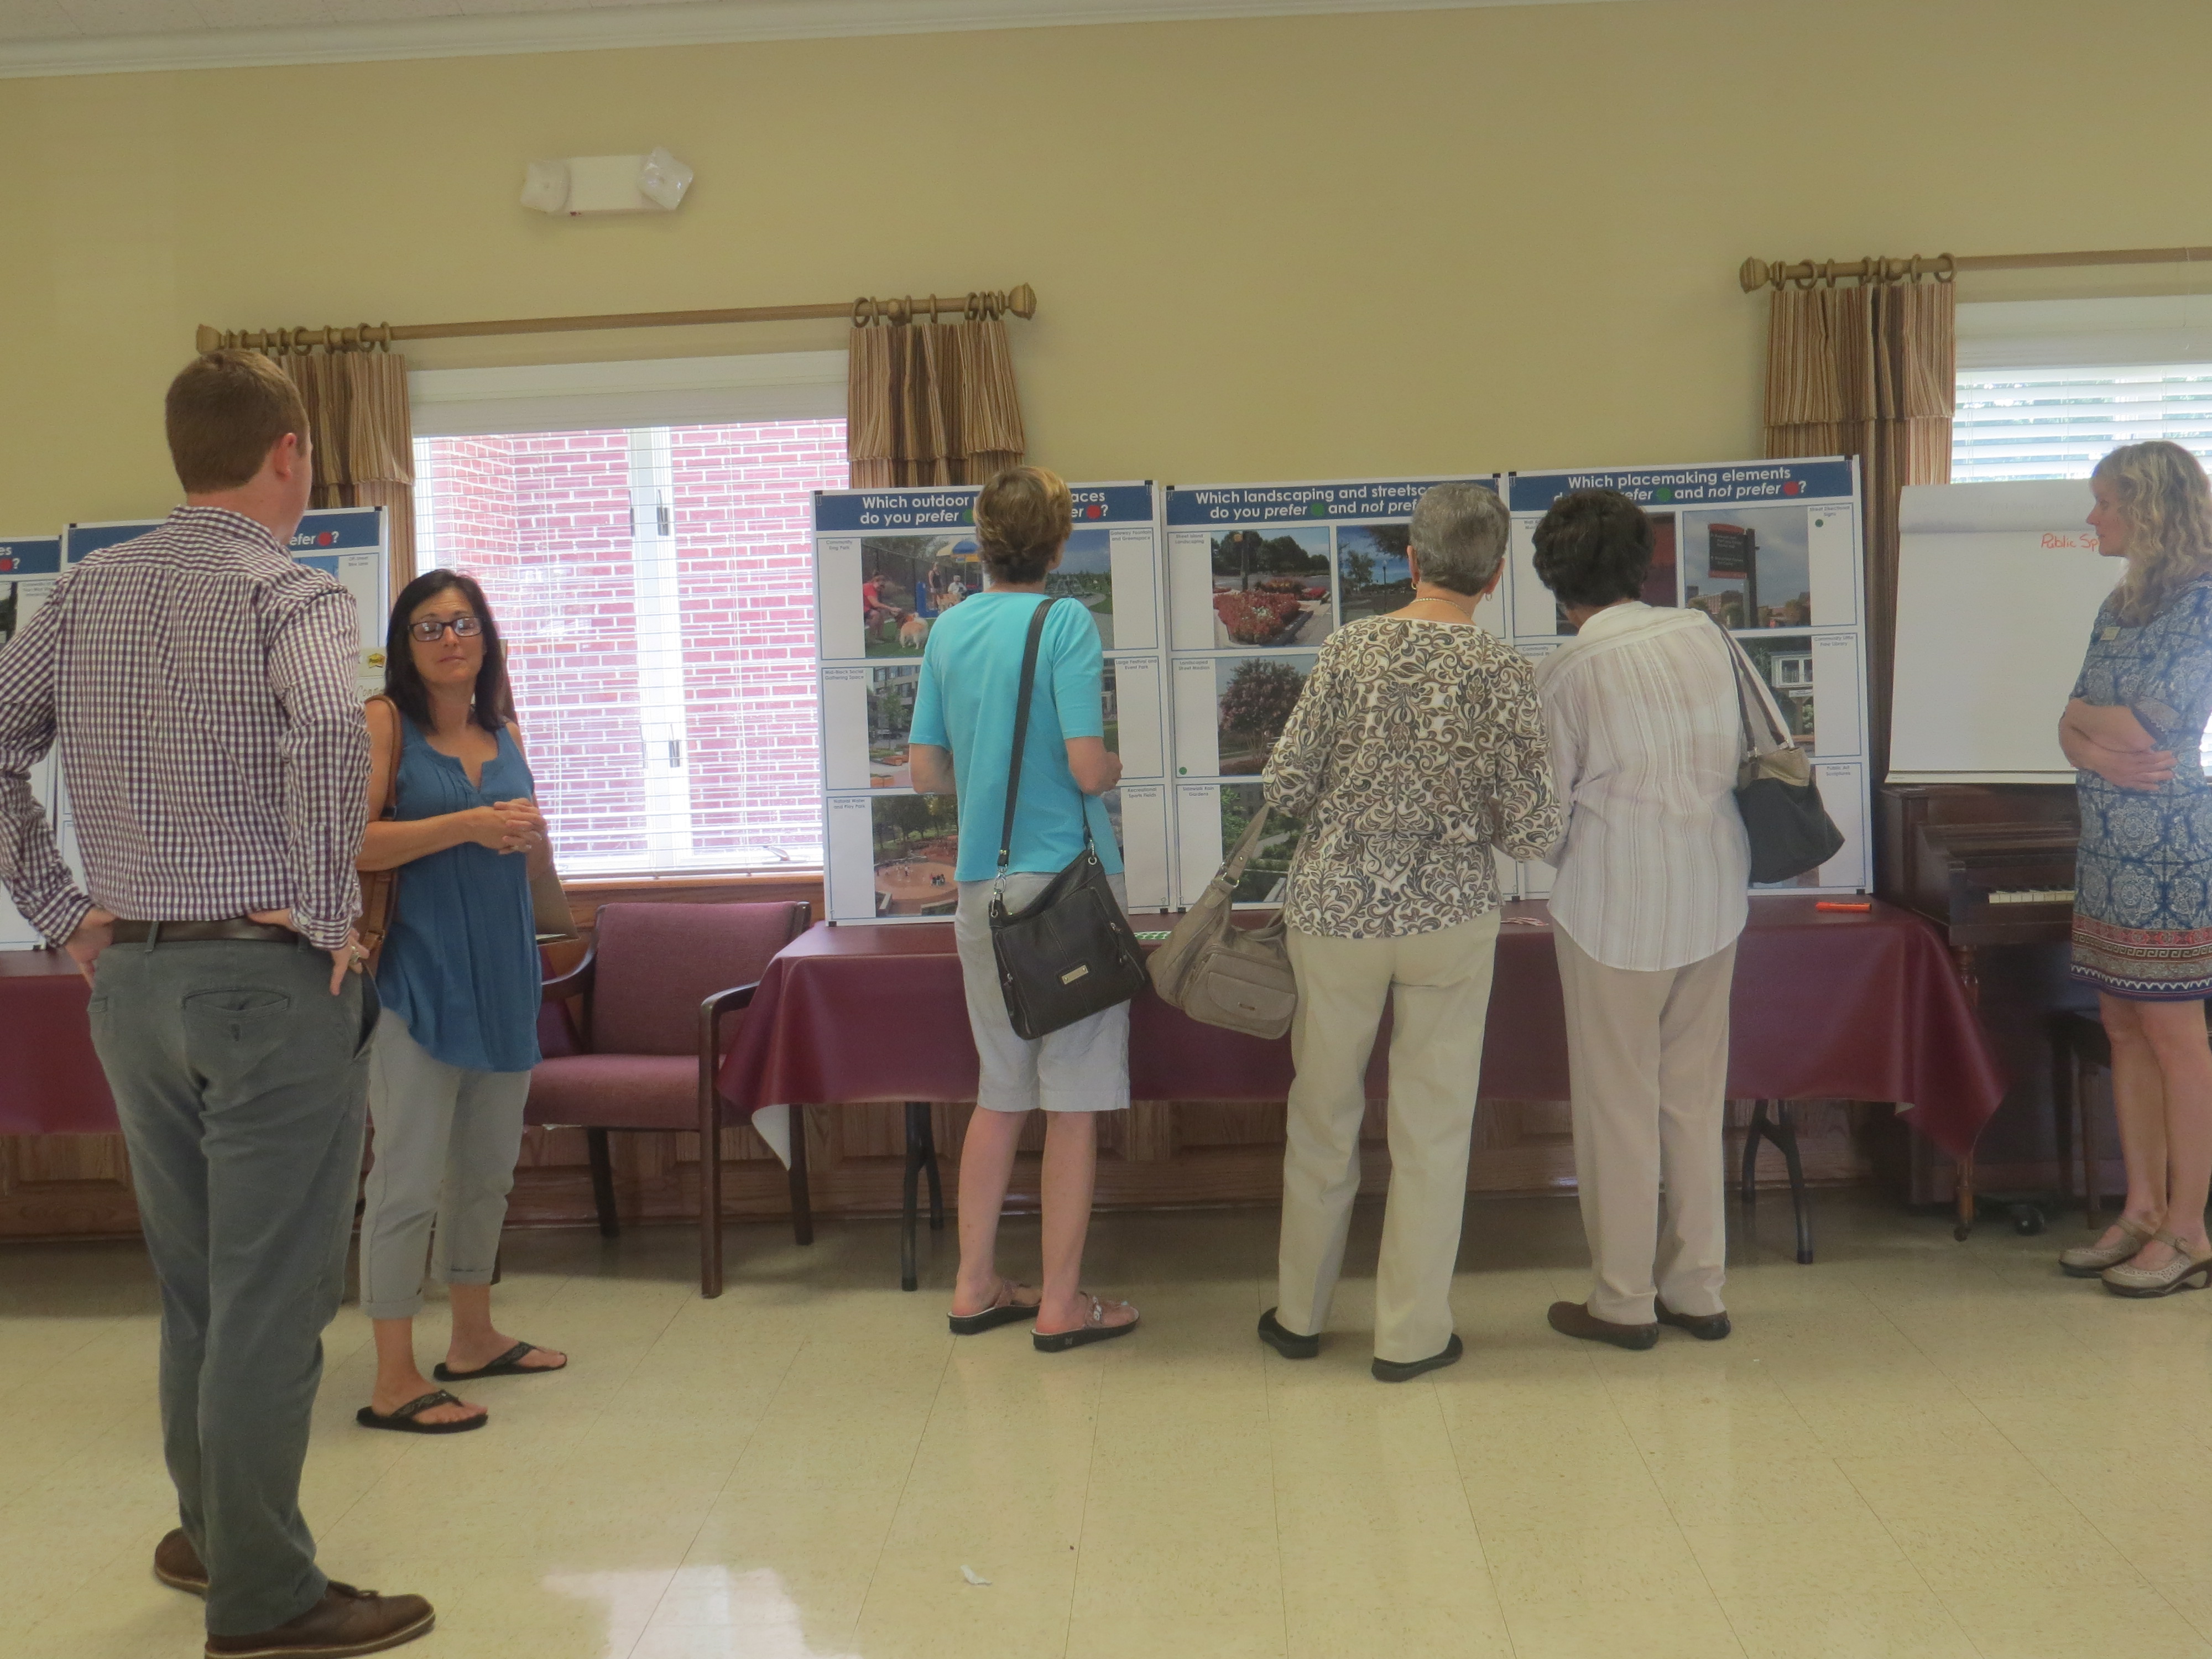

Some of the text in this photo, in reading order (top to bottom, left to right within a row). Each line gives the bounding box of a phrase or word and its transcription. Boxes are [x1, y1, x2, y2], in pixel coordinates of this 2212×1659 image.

[1568, 467, 1791, 489] Which placemaking elements
[1196, 491, 1240, 504] Which
[1244, 488, 1334, 503] landscaping
[1339, 486, 1367, 498] and
[1674, 486, 1704, 499] and
[1708, 485, 1732, 498] not
[1736, 482, 1781, 499] prefer
[862, 495, 907, 509] Which
[912, 494, 969, 508] outdoor
[1071, 492, 1105, 503] aces
[860, 512, 880, 524] do
[884, 513, 911, 526] you
[916, 509, 959, 525] prefer
[1210, 499, 1417, 520] do you prefer and not pref
[289, 533, 316, 546] efer
[2041, 533, 2077, 549] Public
